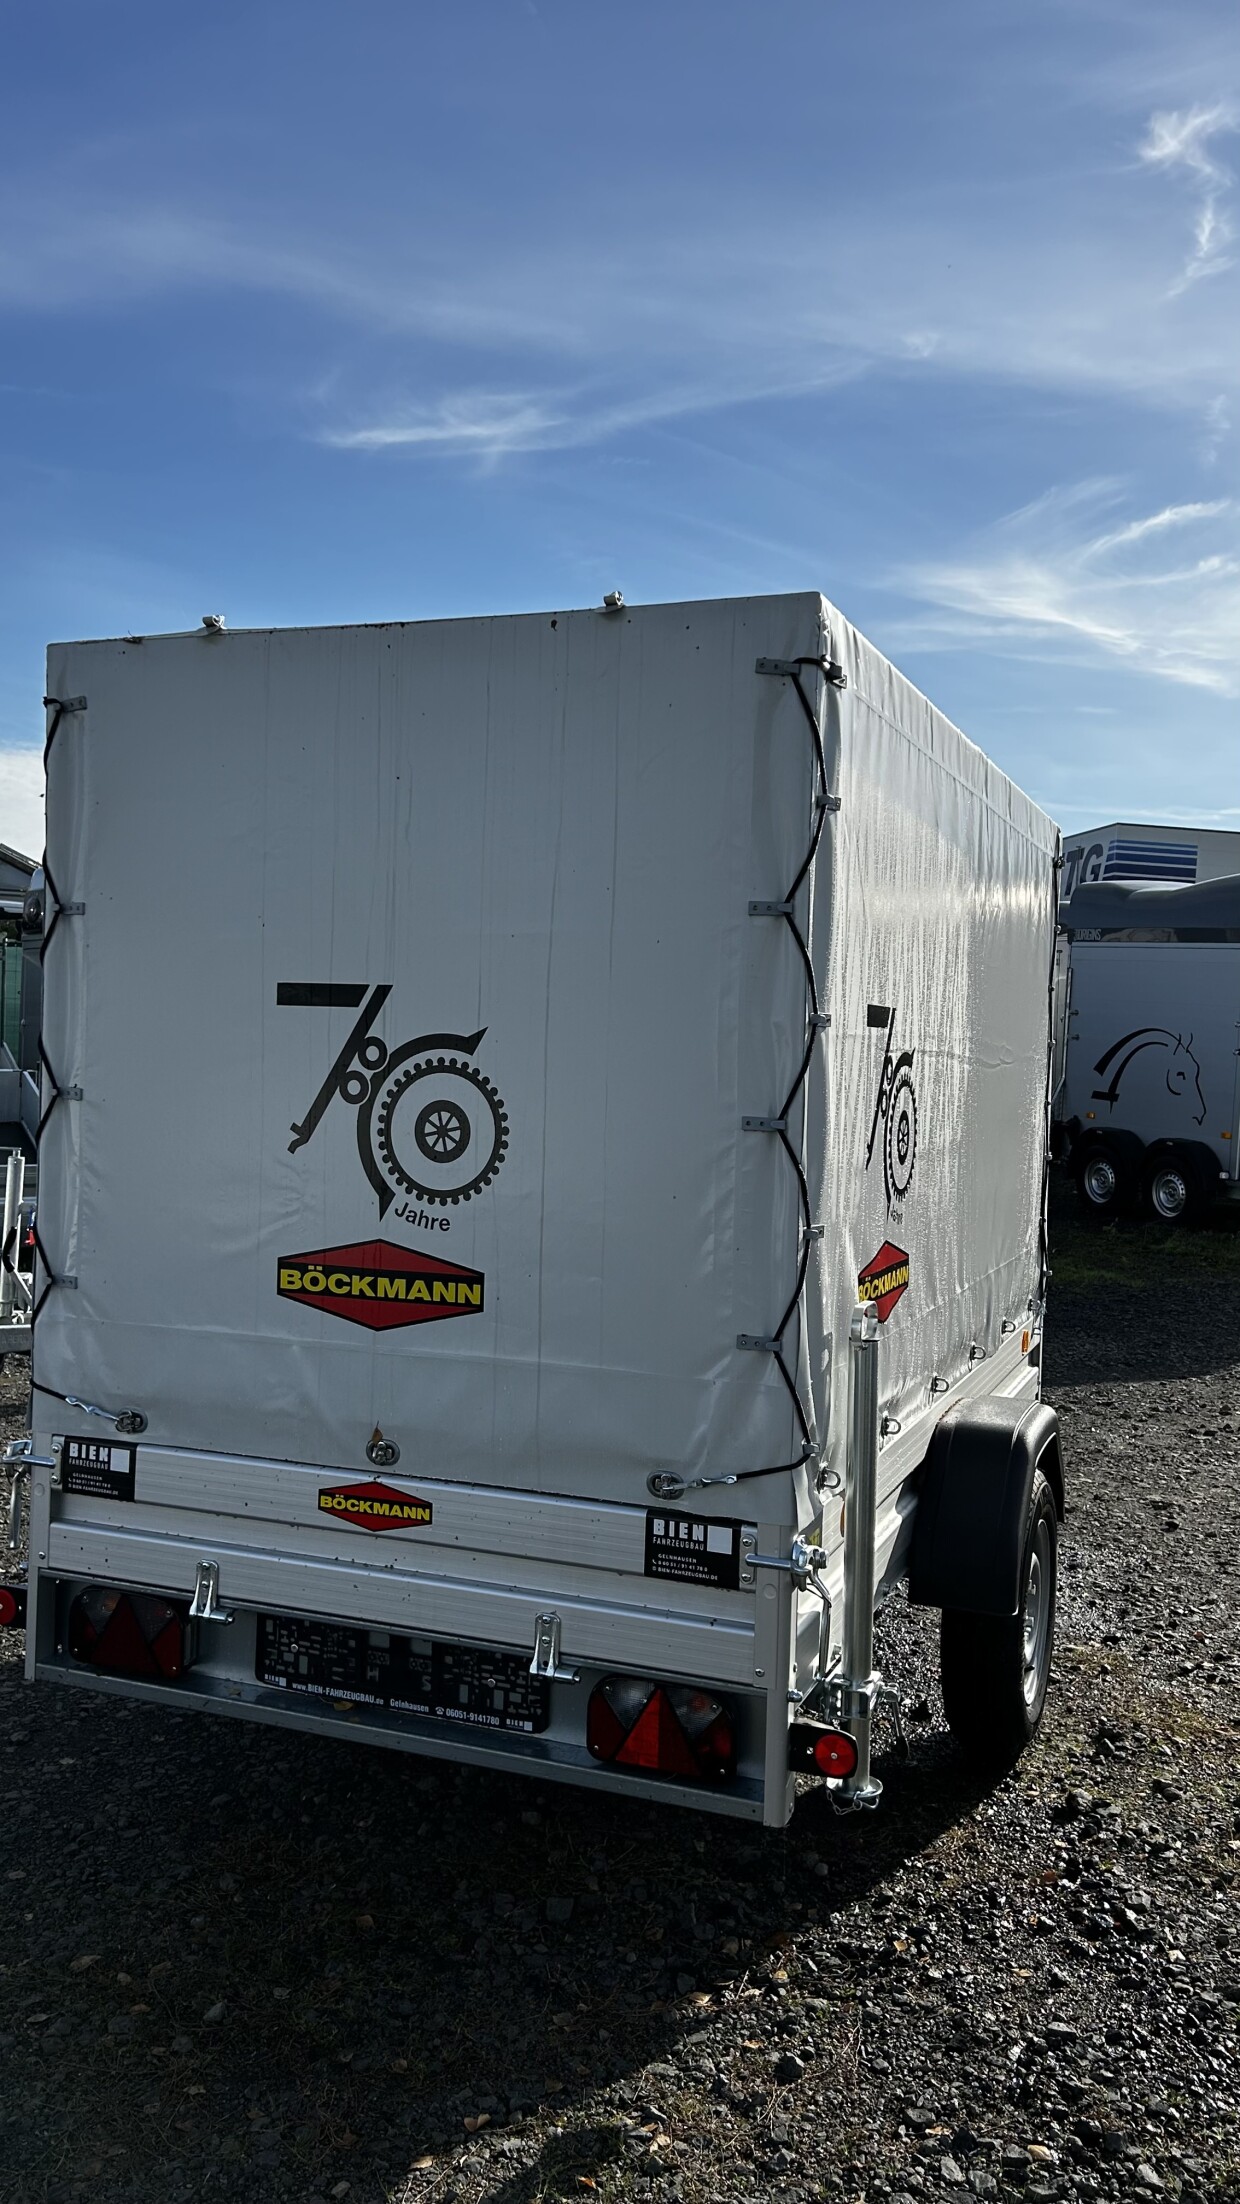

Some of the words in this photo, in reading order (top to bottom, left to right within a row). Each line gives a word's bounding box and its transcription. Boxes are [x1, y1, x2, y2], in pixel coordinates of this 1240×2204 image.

[394, 1202, 451, 1232] Jahre
[280, 1265, 481, 1305] BÖCKMANN
[69, 1442, 109, 1462] BIEN
[69, 1458, 109, 1470] FAHRZEUGBAU
[320, 1495, 430, 1521] BÖCKMANN
[653, 1518, 704, 1542] BIEN
[653, 1536, 704, 1551] FAHRZEUGBAU
[658, 1553, 696, 1563] GELNHAUSEN
[292, 1682, 384, 1705] www.BIEN-FAHRZEUGBAU.de
[390, 1698, 429, 1713] Gelnhausen
[445, 1707, 500, 1726] 06051-9141780
